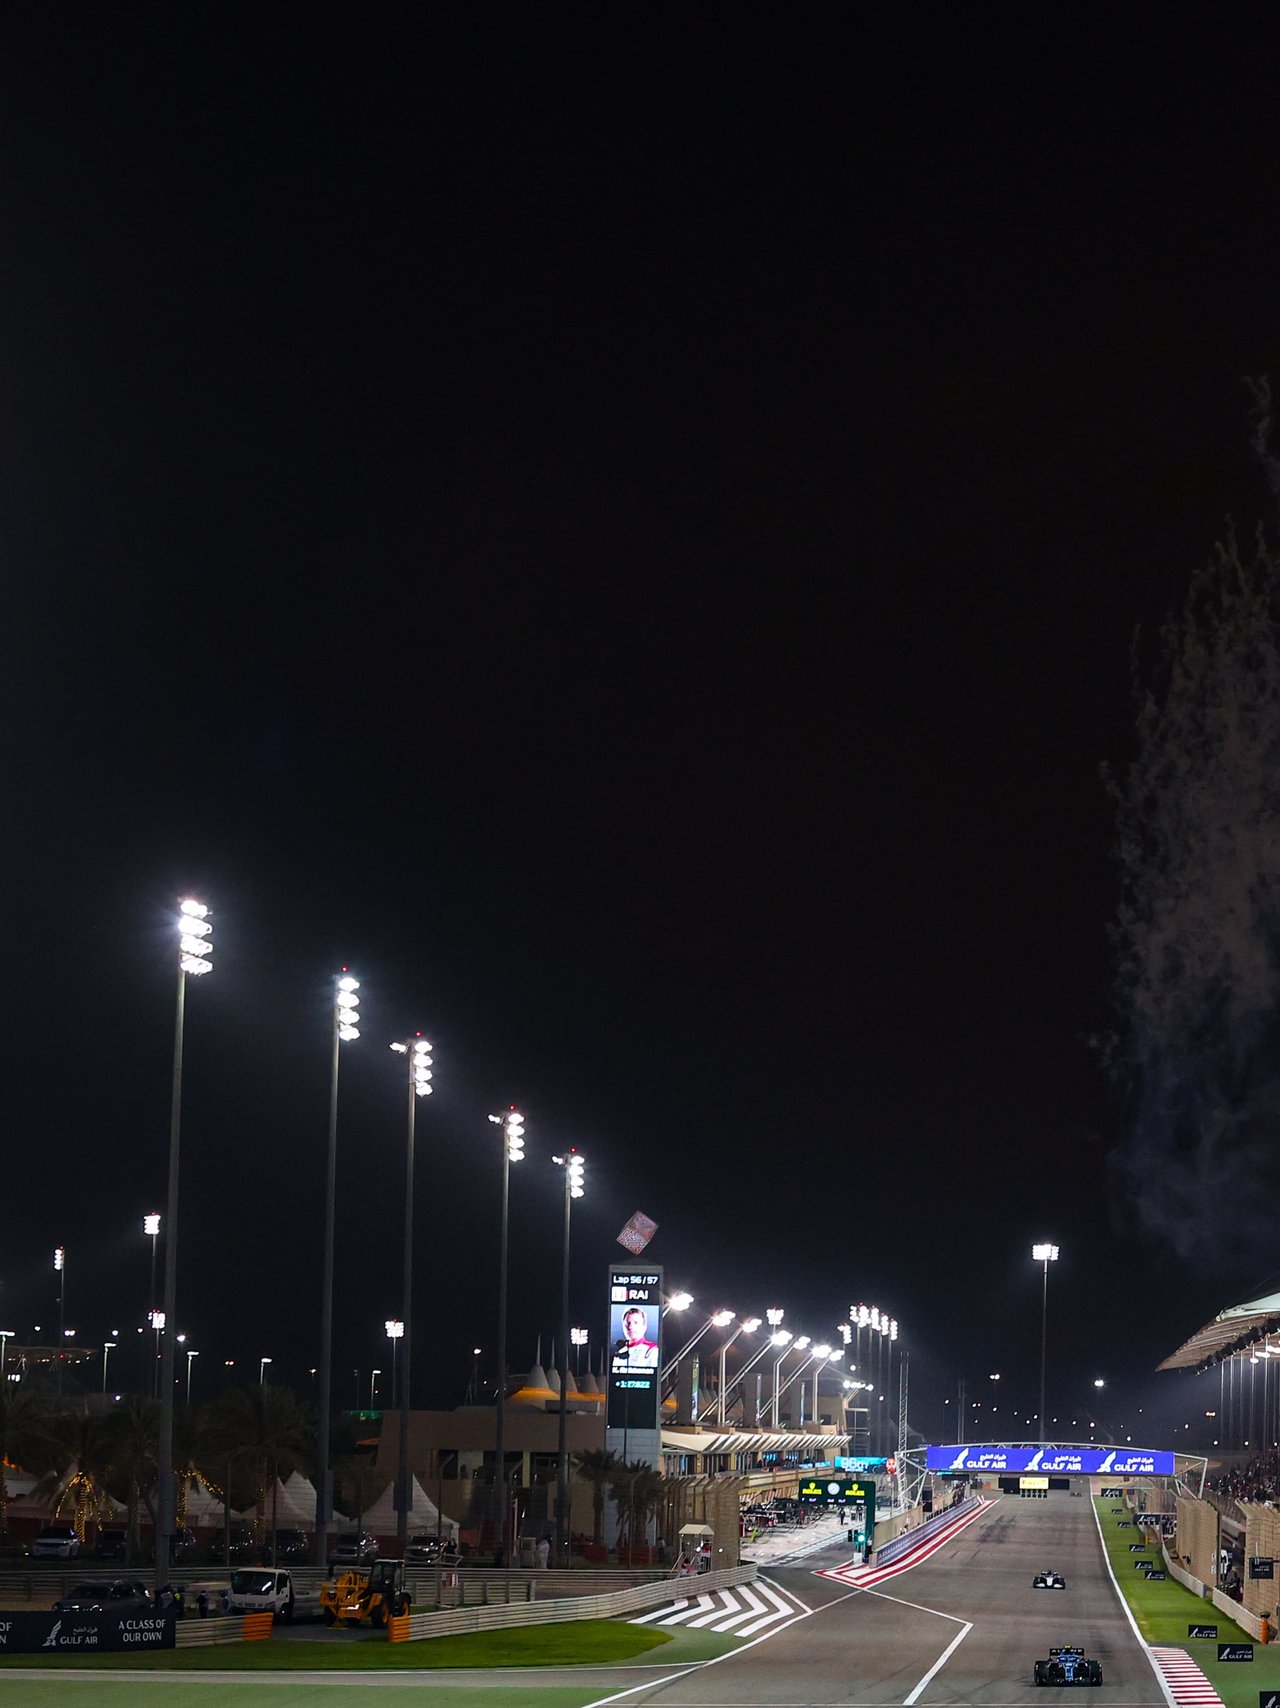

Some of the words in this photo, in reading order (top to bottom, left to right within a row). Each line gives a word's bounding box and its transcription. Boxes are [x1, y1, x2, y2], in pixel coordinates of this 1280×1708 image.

[613, 1275, 629, 1284] Lap
[630, 1275, 642, 1284] 56
[647, 1276, 658, 1285] 57
[629, 1289, 649, 1300] RAI
[966, 1460, 990, 1469] GULF
[991, 1461, 1007, 1469] AIR
[1041, 1462, 1066, 1470] GULF
[1066, 1463, 1081, 1471] AIR
[1114, 1463, 1138, 1472] GULF
[1138, 1464, 1154, 1472] AIR
[118, 1620, 125, 1630] A
[126, 1619, 154, 1630] CLASS
[155, 1619, 166, 1629] OF
[60, 1636, 83, 1644] GULF
[84, 1636, 98, 1644] AIR
[122, 1632, 141, 1642] OUR
[142, 1631, 162, 1641] OWN
